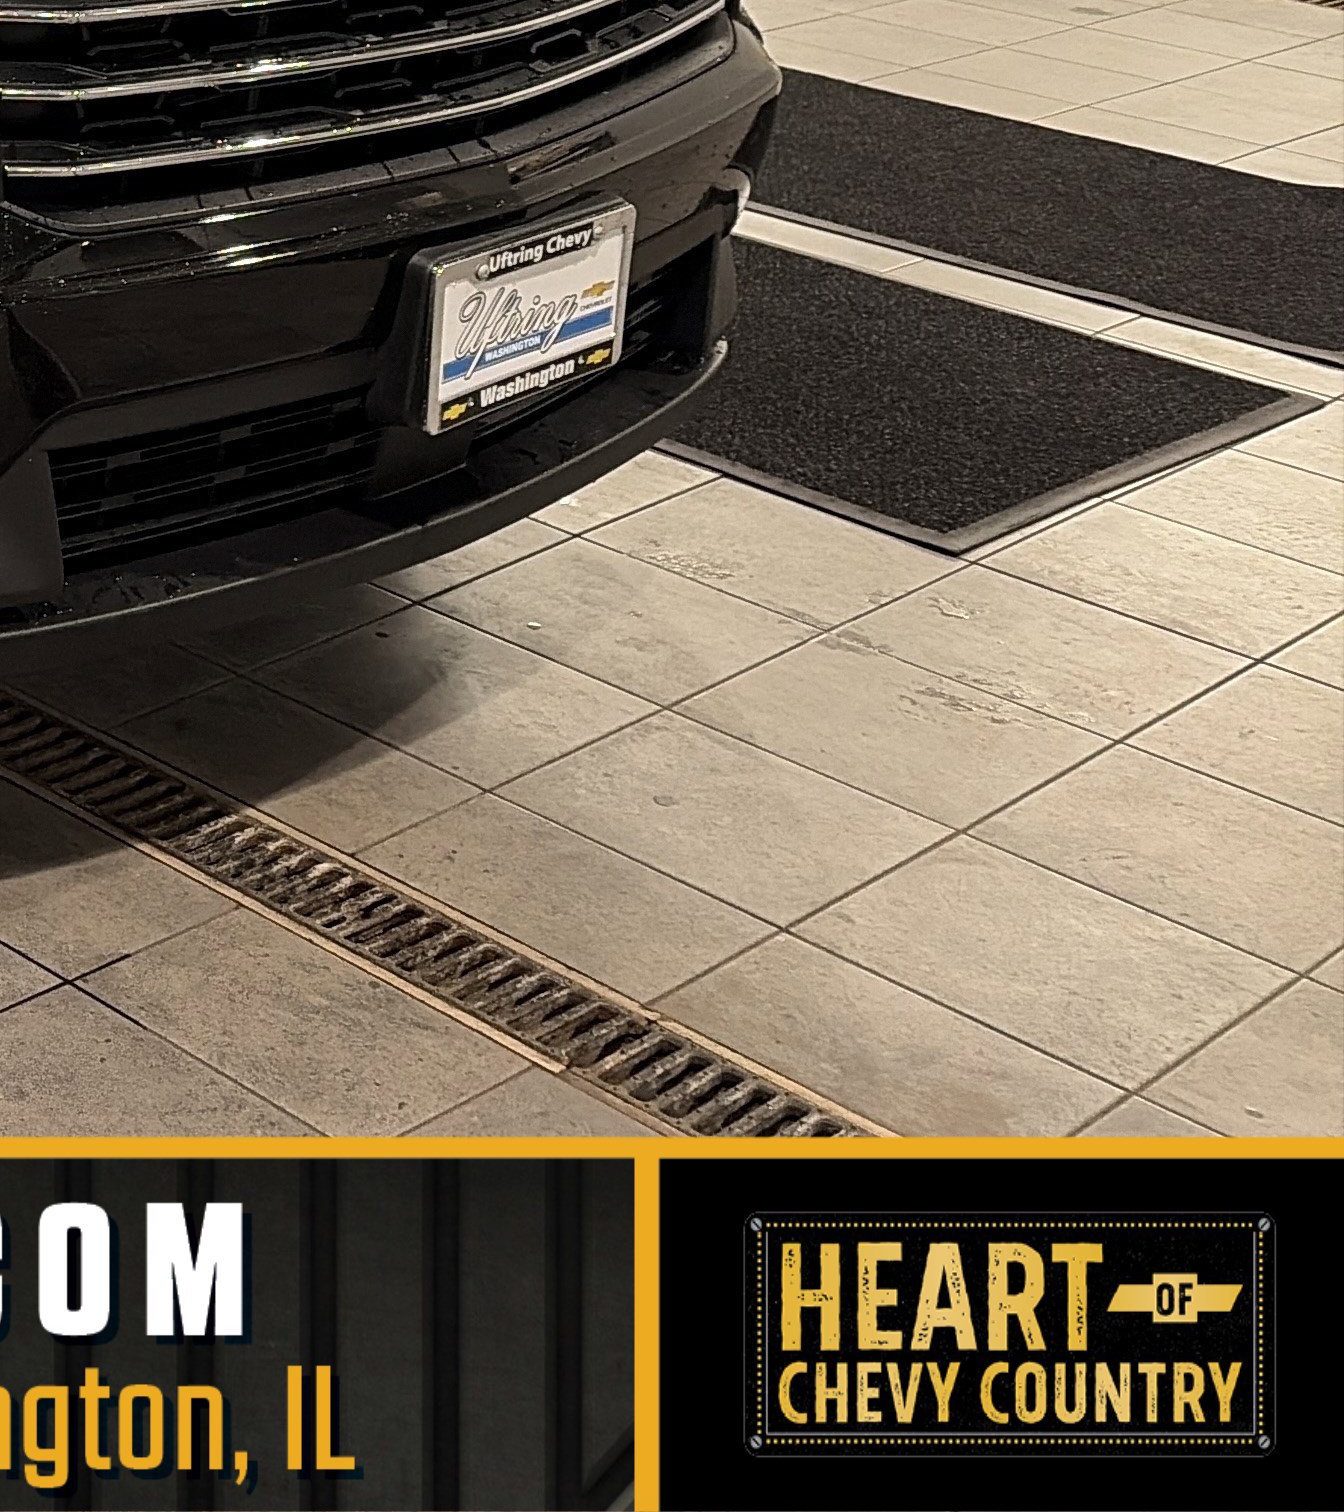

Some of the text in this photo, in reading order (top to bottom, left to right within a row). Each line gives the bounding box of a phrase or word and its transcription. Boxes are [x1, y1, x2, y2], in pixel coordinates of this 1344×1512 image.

[489, 228, 593, 273] Uftring Chevy
[579, 296, 612, 311] CHEVROLET
[456, 286, 578, 379] Uftring
[484, 336, 541, 361] WASHINGTON
[480, 359, 576, 407] Washington
